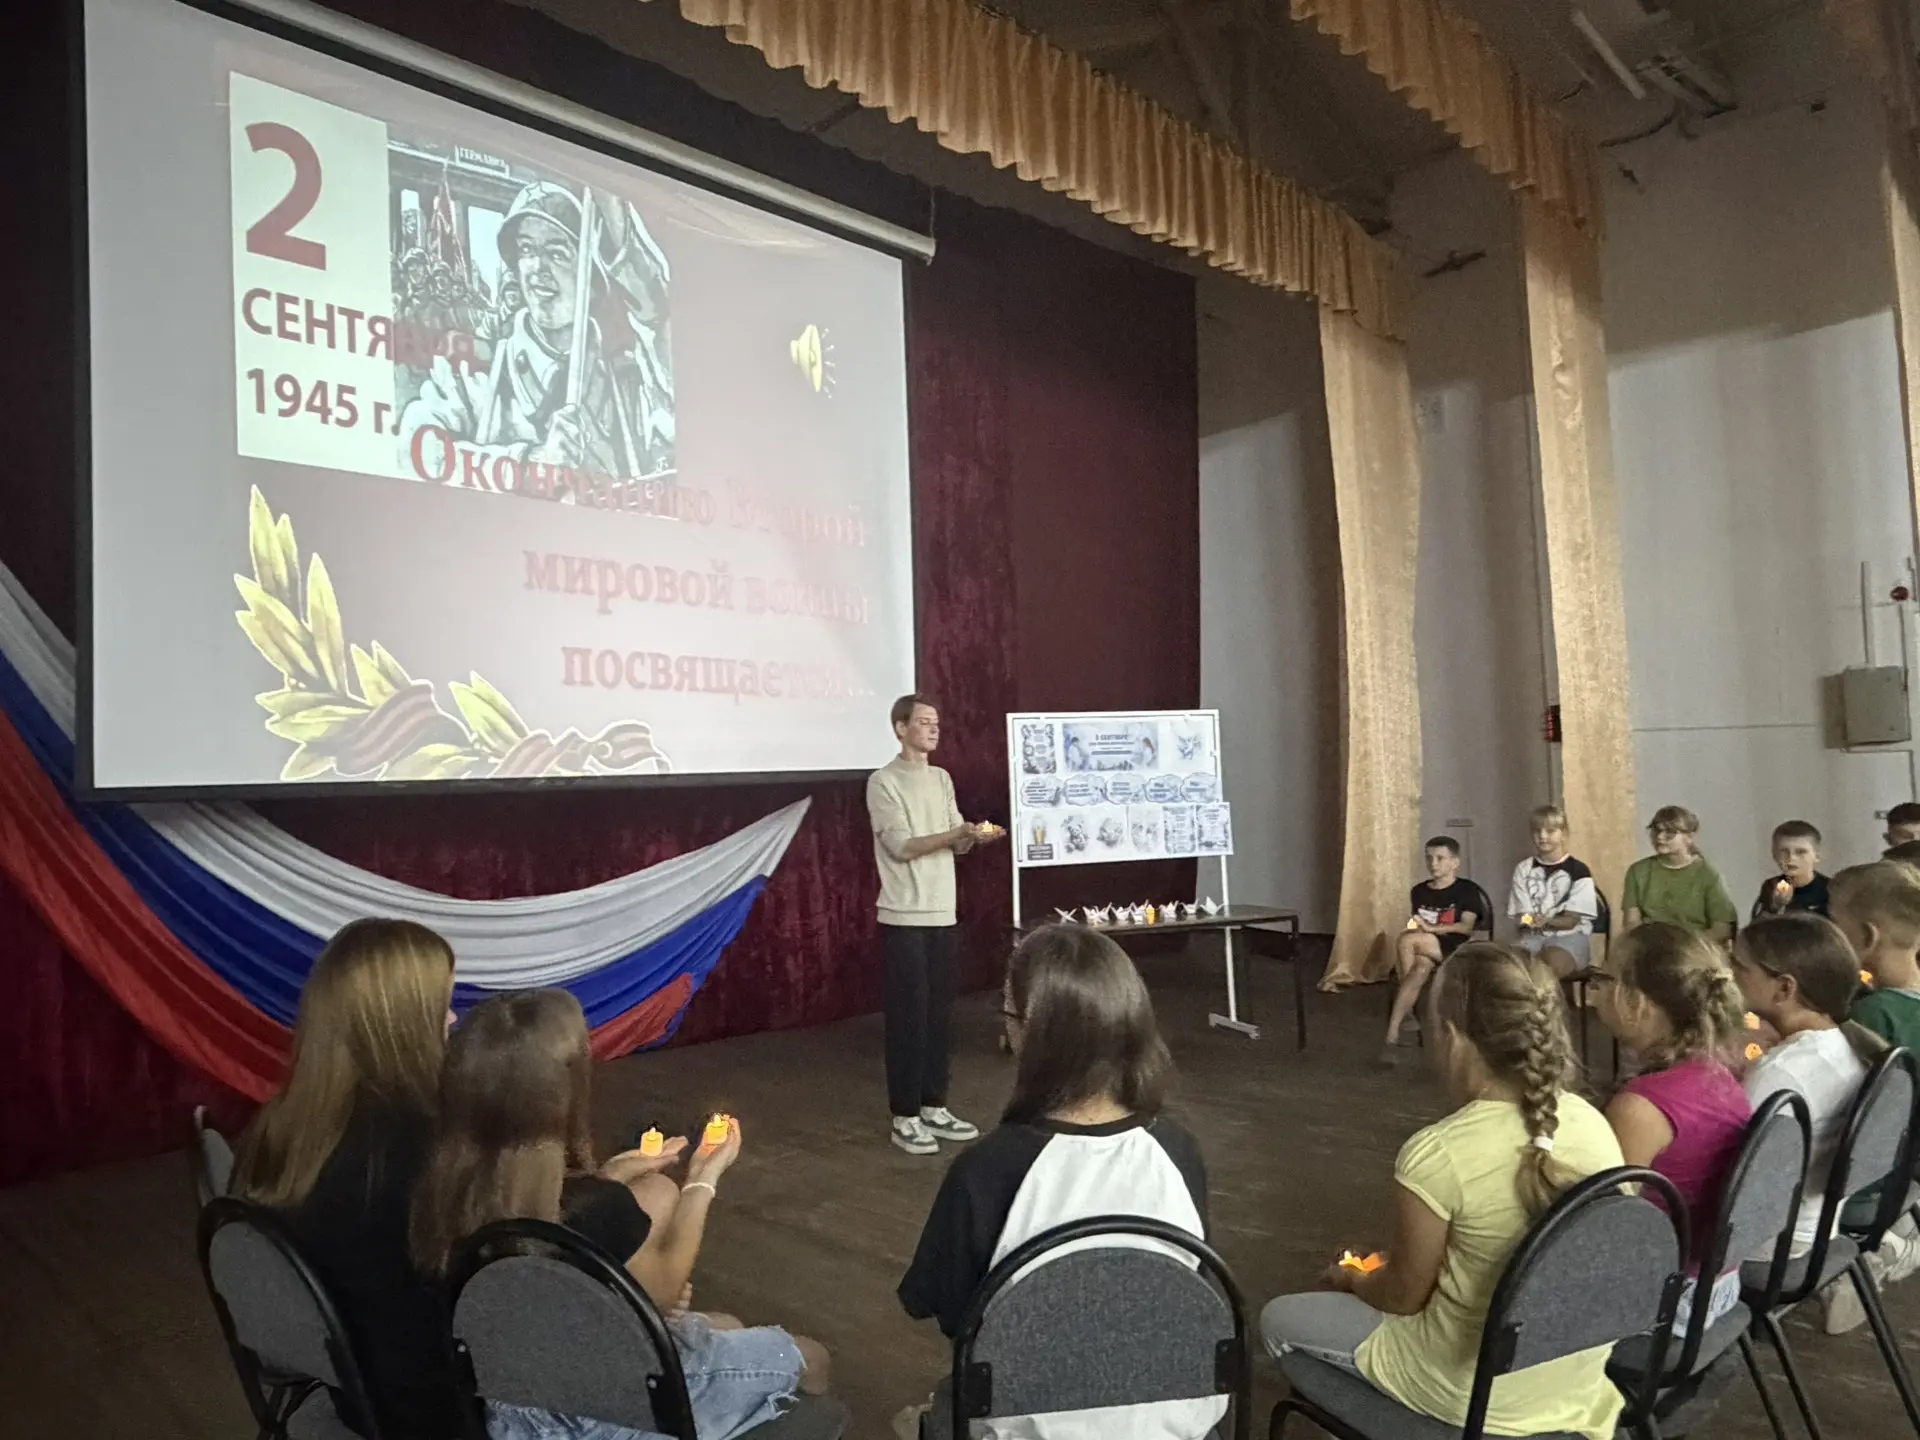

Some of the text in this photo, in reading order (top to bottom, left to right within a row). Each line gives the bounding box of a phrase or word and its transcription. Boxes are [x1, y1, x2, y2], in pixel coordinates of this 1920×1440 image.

[244, 121, 327, 272] 2
[246, 367, 402, 437] 1945 г.
[522, 549, 735, 615] мировой
